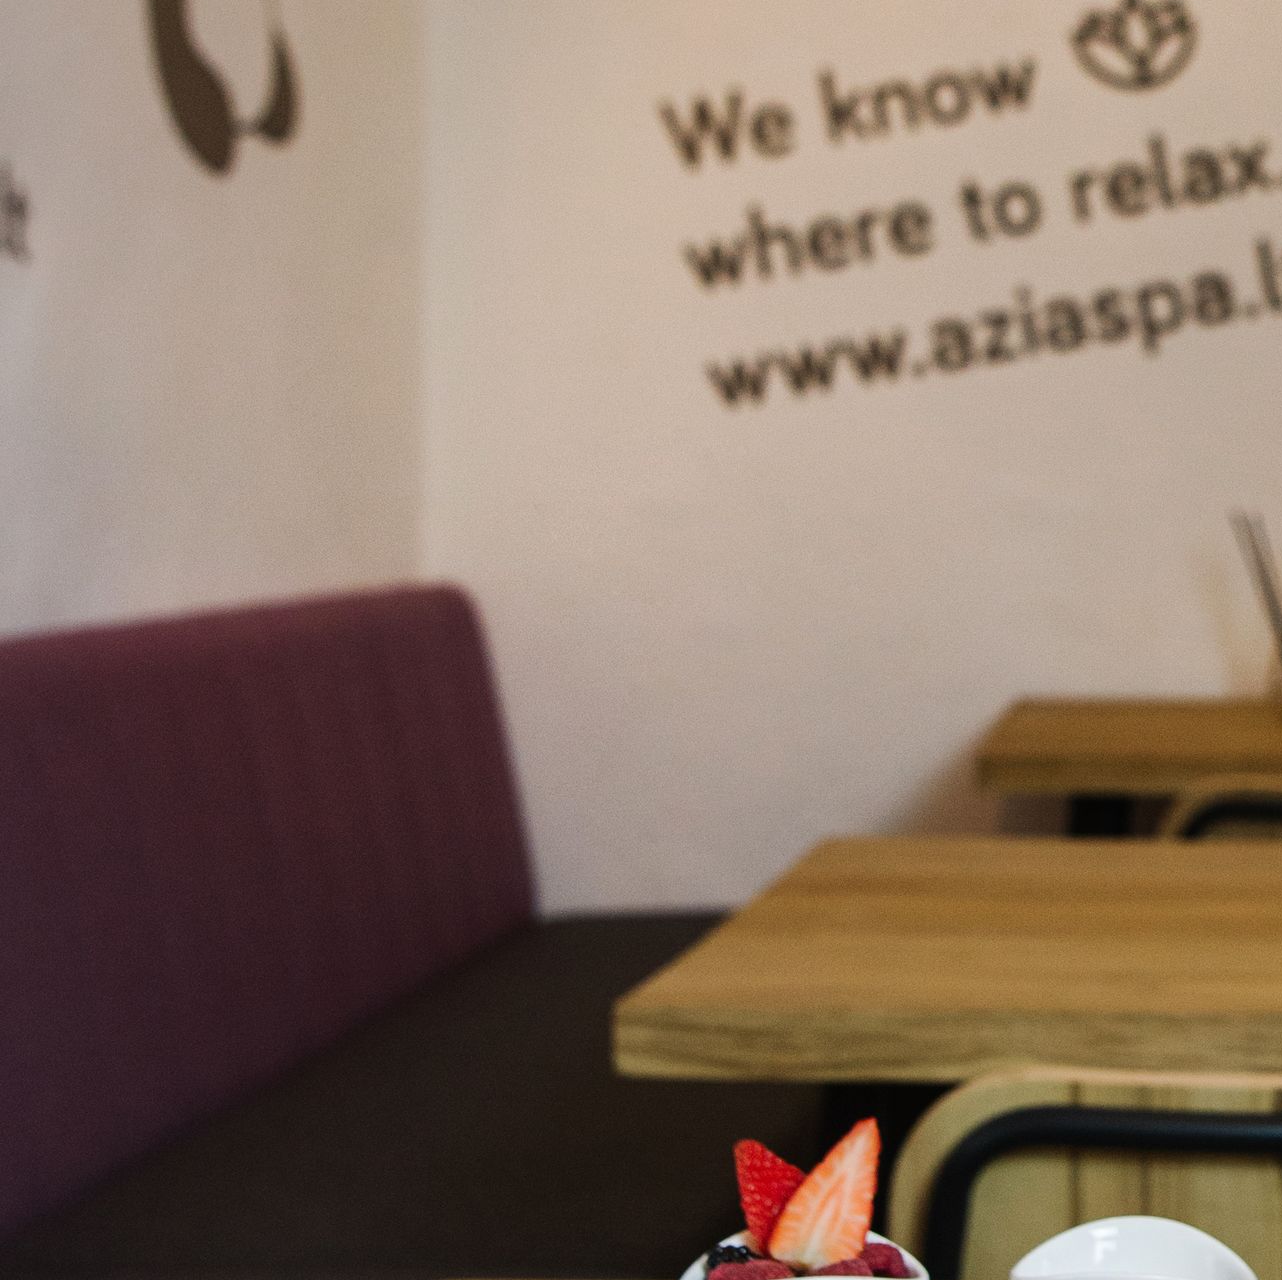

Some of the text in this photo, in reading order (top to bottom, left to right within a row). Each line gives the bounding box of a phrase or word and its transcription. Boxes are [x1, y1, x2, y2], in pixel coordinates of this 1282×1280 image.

[657, 57, 1038, 172] We know
[682, 200, 935, 292] where
[957, 179, 1045, 243] to
